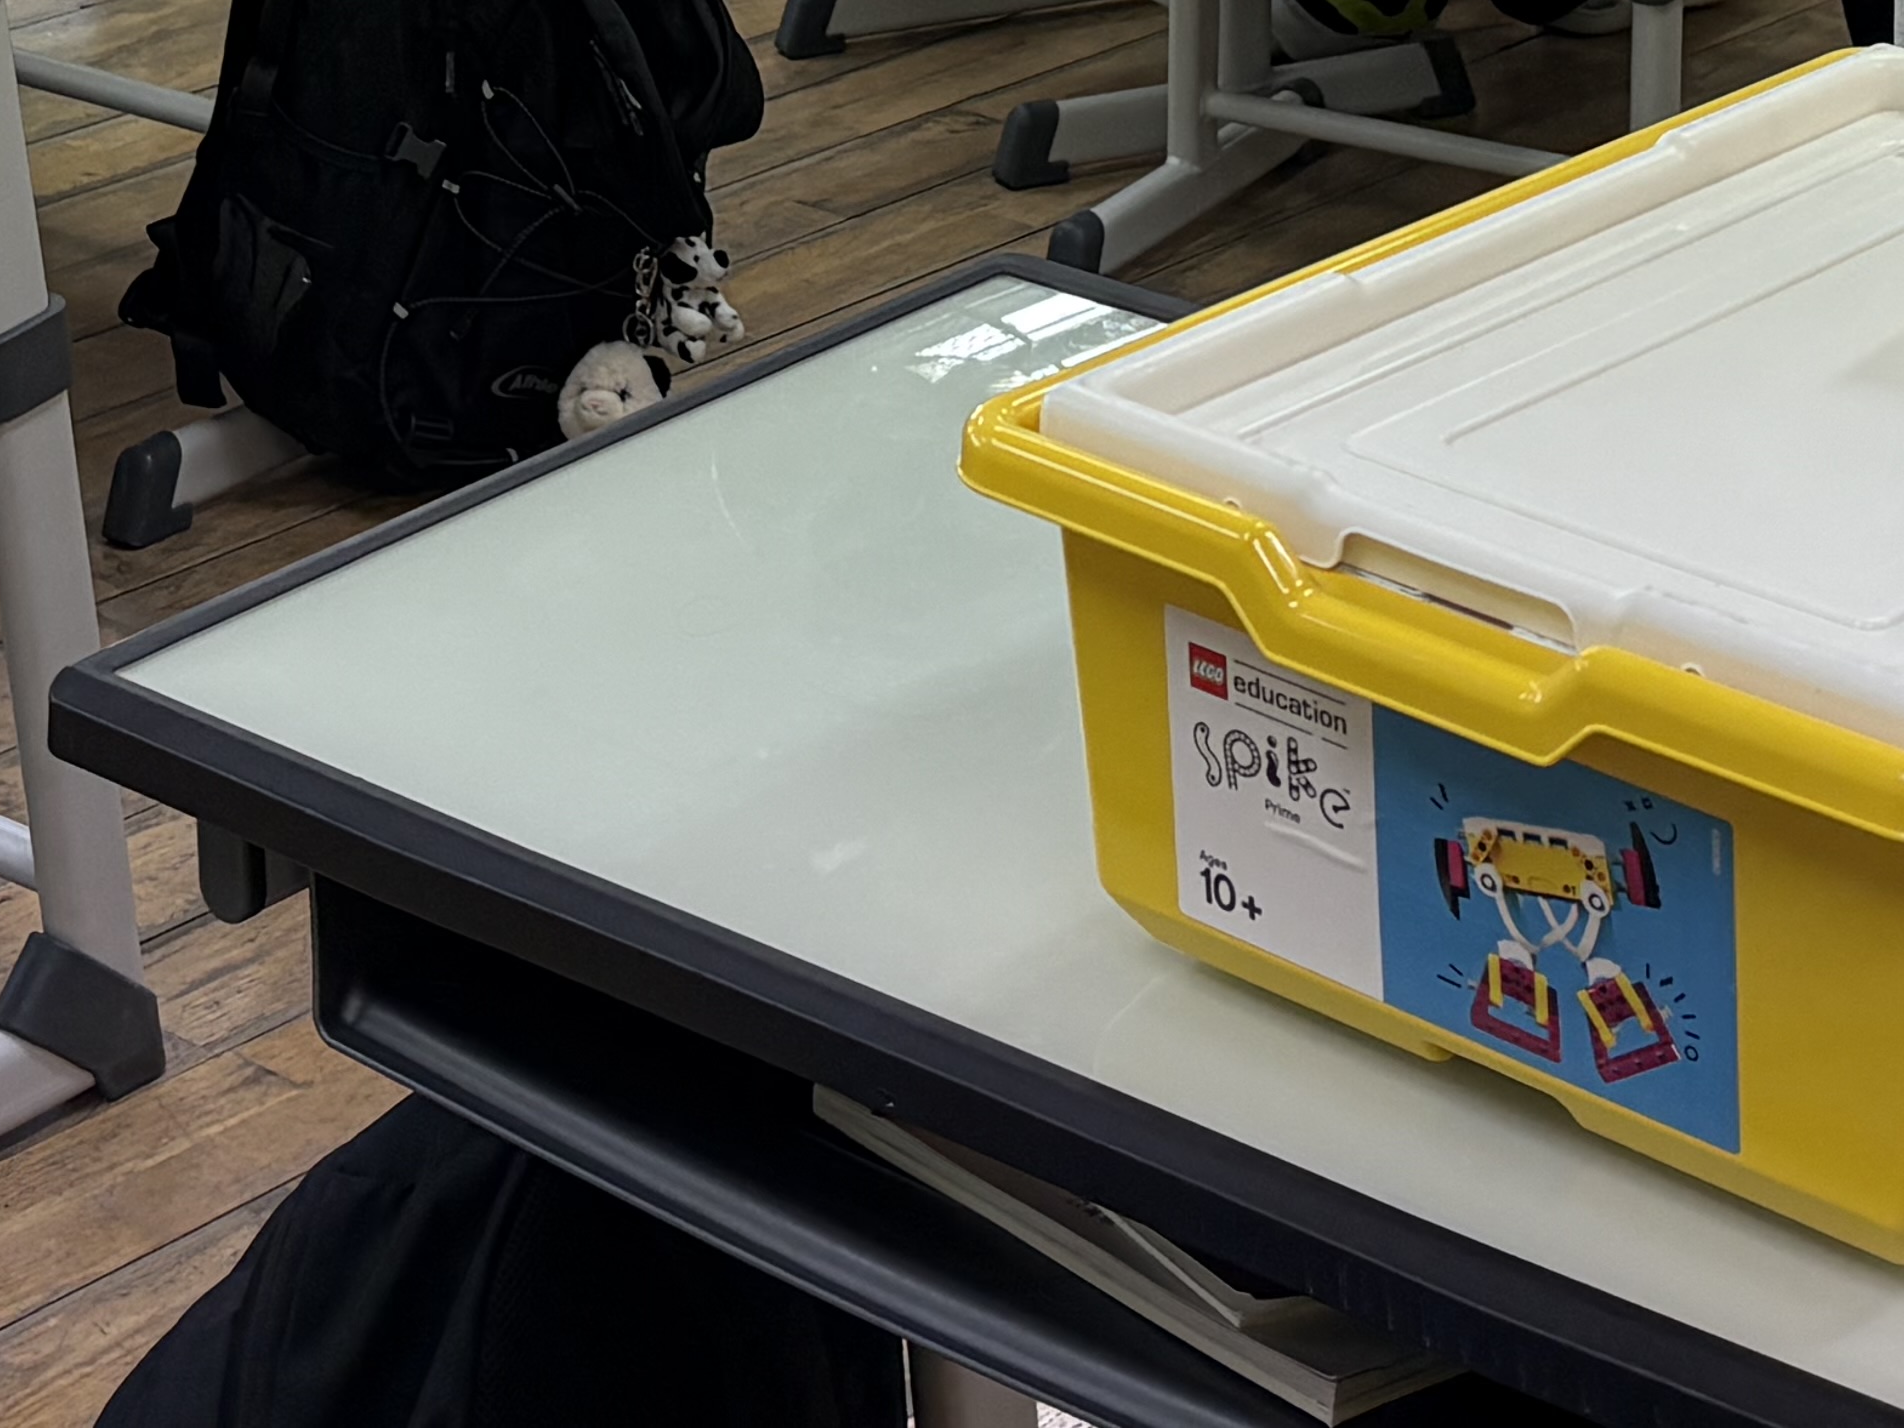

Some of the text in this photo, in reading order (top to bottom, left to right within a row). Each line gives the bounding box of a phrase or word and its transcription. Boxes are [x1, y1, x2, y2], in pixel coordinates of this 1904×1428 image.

[1193, 659, 1347, 734] LEGO education
[1265, 797, 1301, 824] Prime
[1199, 849, 1228, 871] Ages
[1200, 866, 1263, 921] 10+
